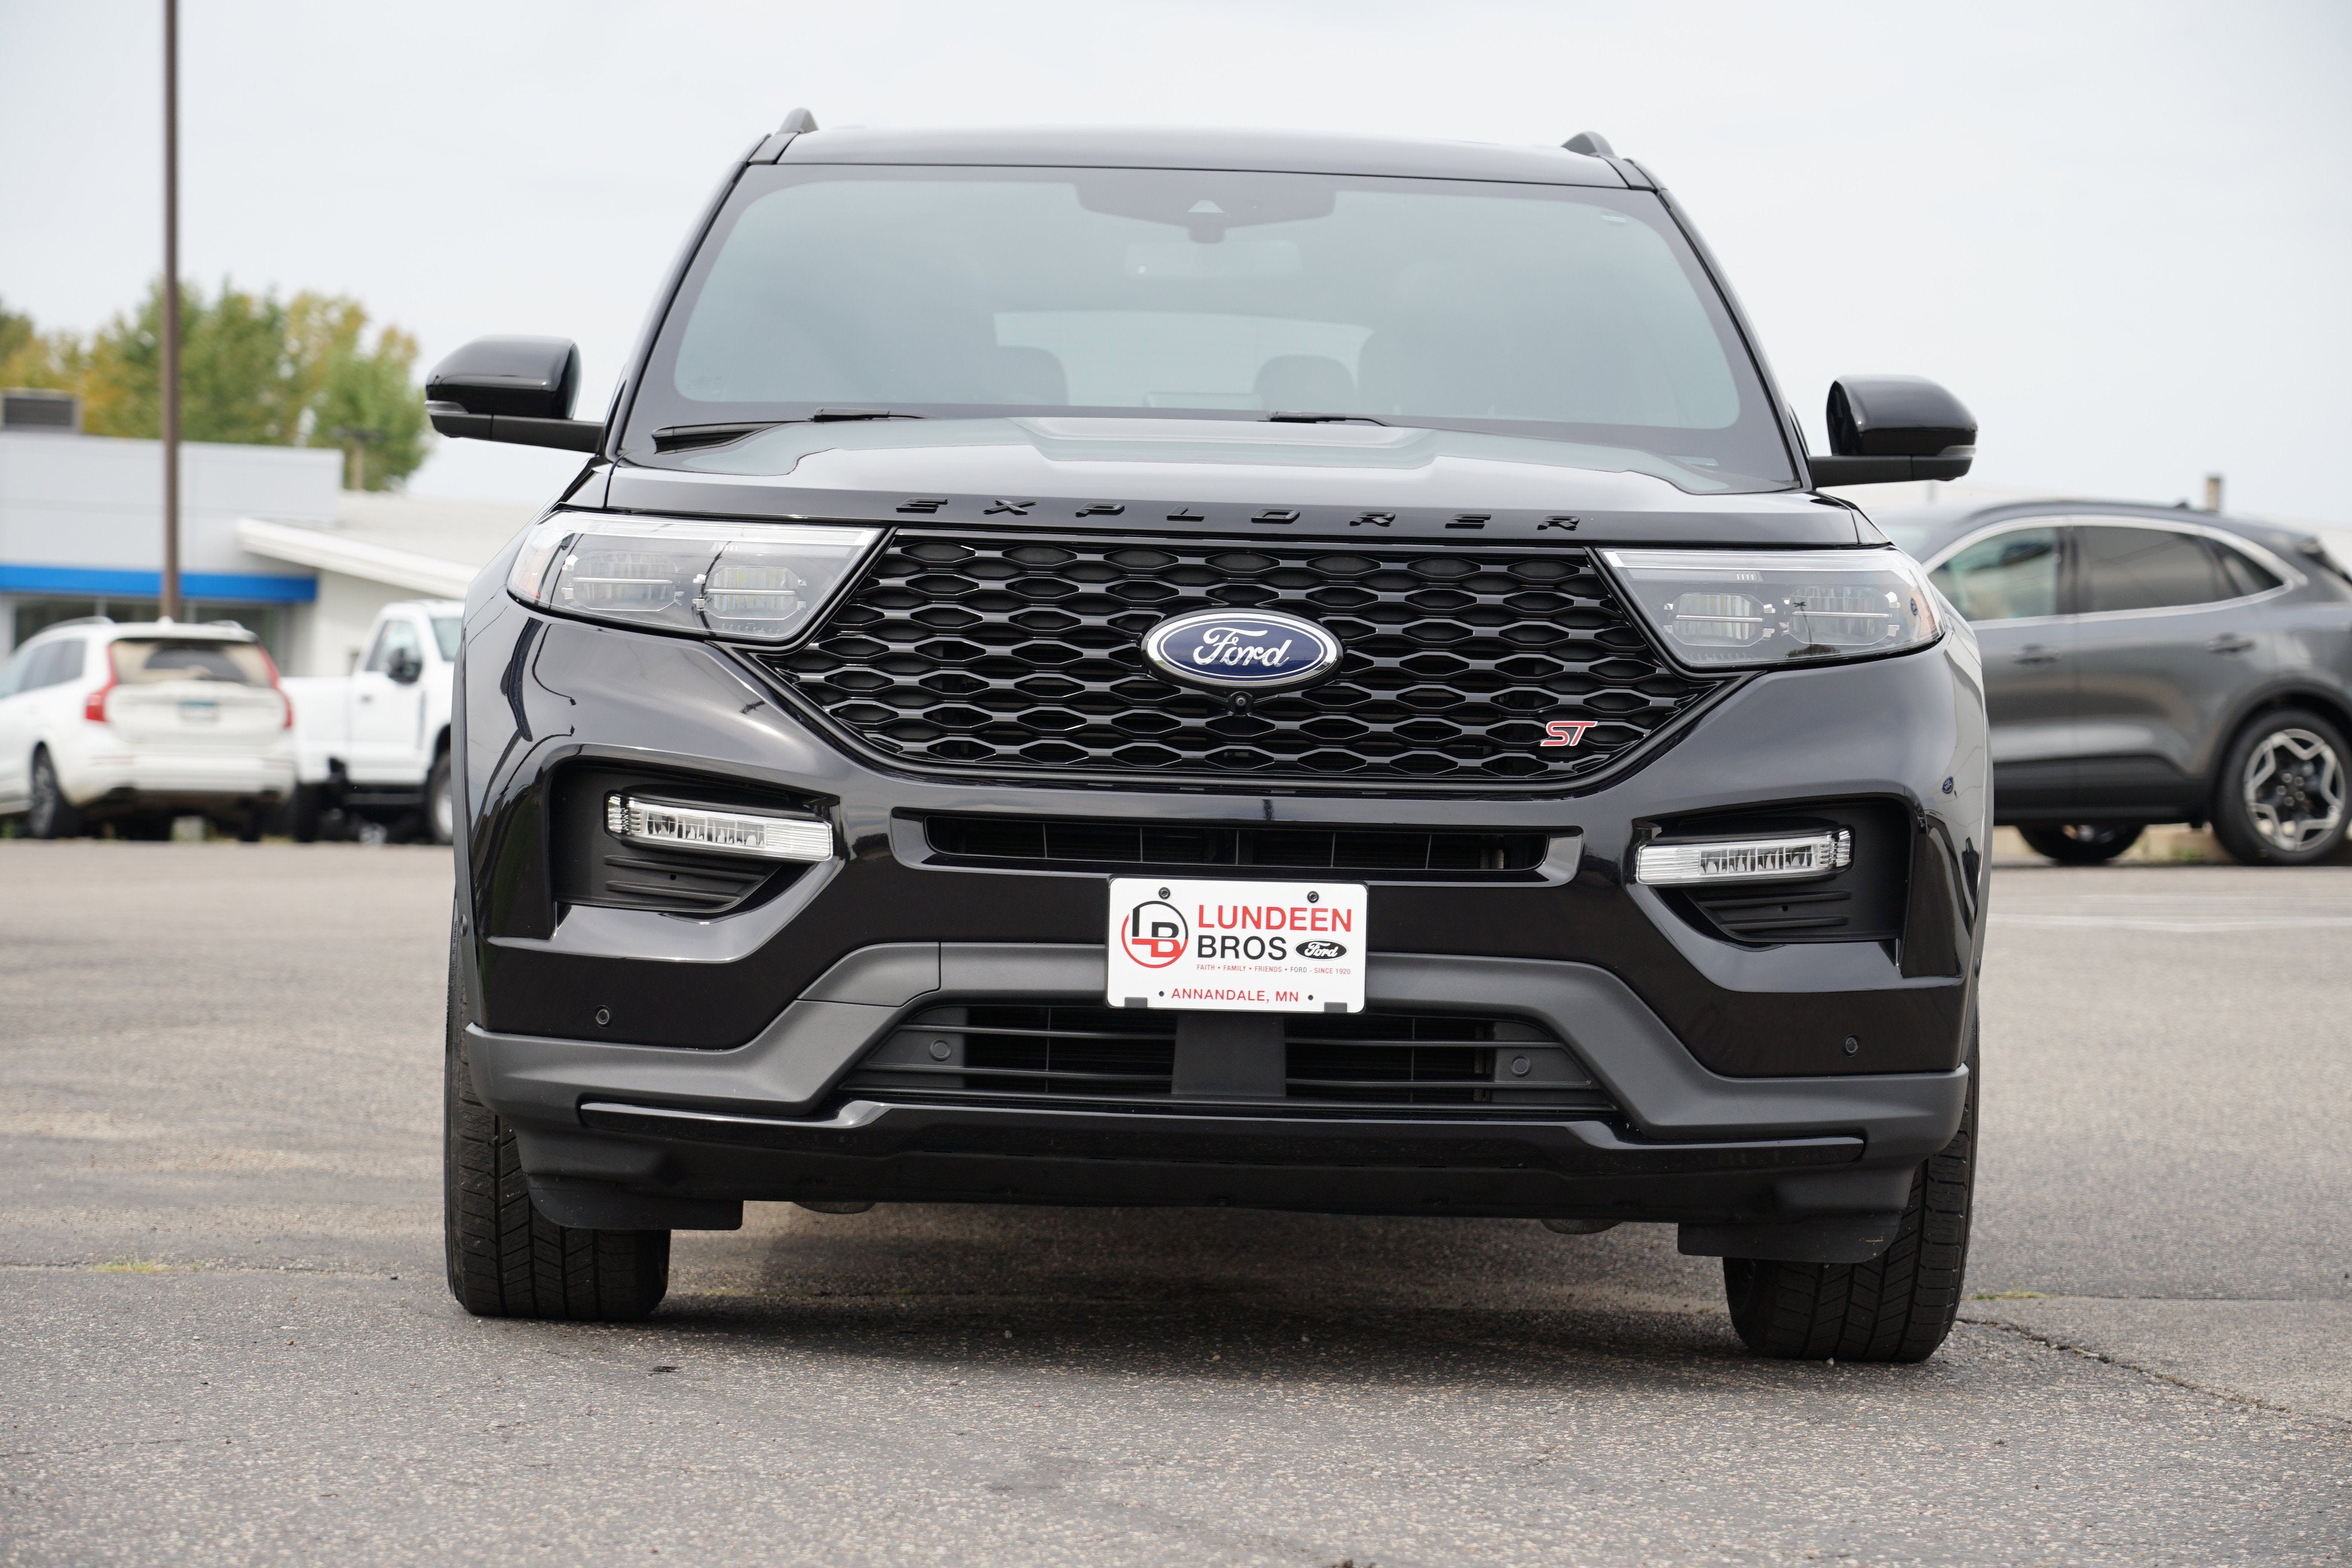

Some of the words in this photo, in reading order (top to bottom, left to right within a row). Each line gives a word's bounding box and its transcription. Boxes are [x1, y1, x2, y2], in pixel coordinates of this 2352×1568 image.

[896, 498, 1580, 531] EXPLORER
[1193, 627, 1292, 667] Ford
[1540, 721, 1598, 746] ST
[1198, 905, 1351, 932] LUNDEEN
[1198, 935, 1287, 960] BROS
[1304, 942, 1339, 957] Ford
[1171, 988, 1269, 1003] ANNANDALE,
[1275, 991, 1298, 1002] MN
